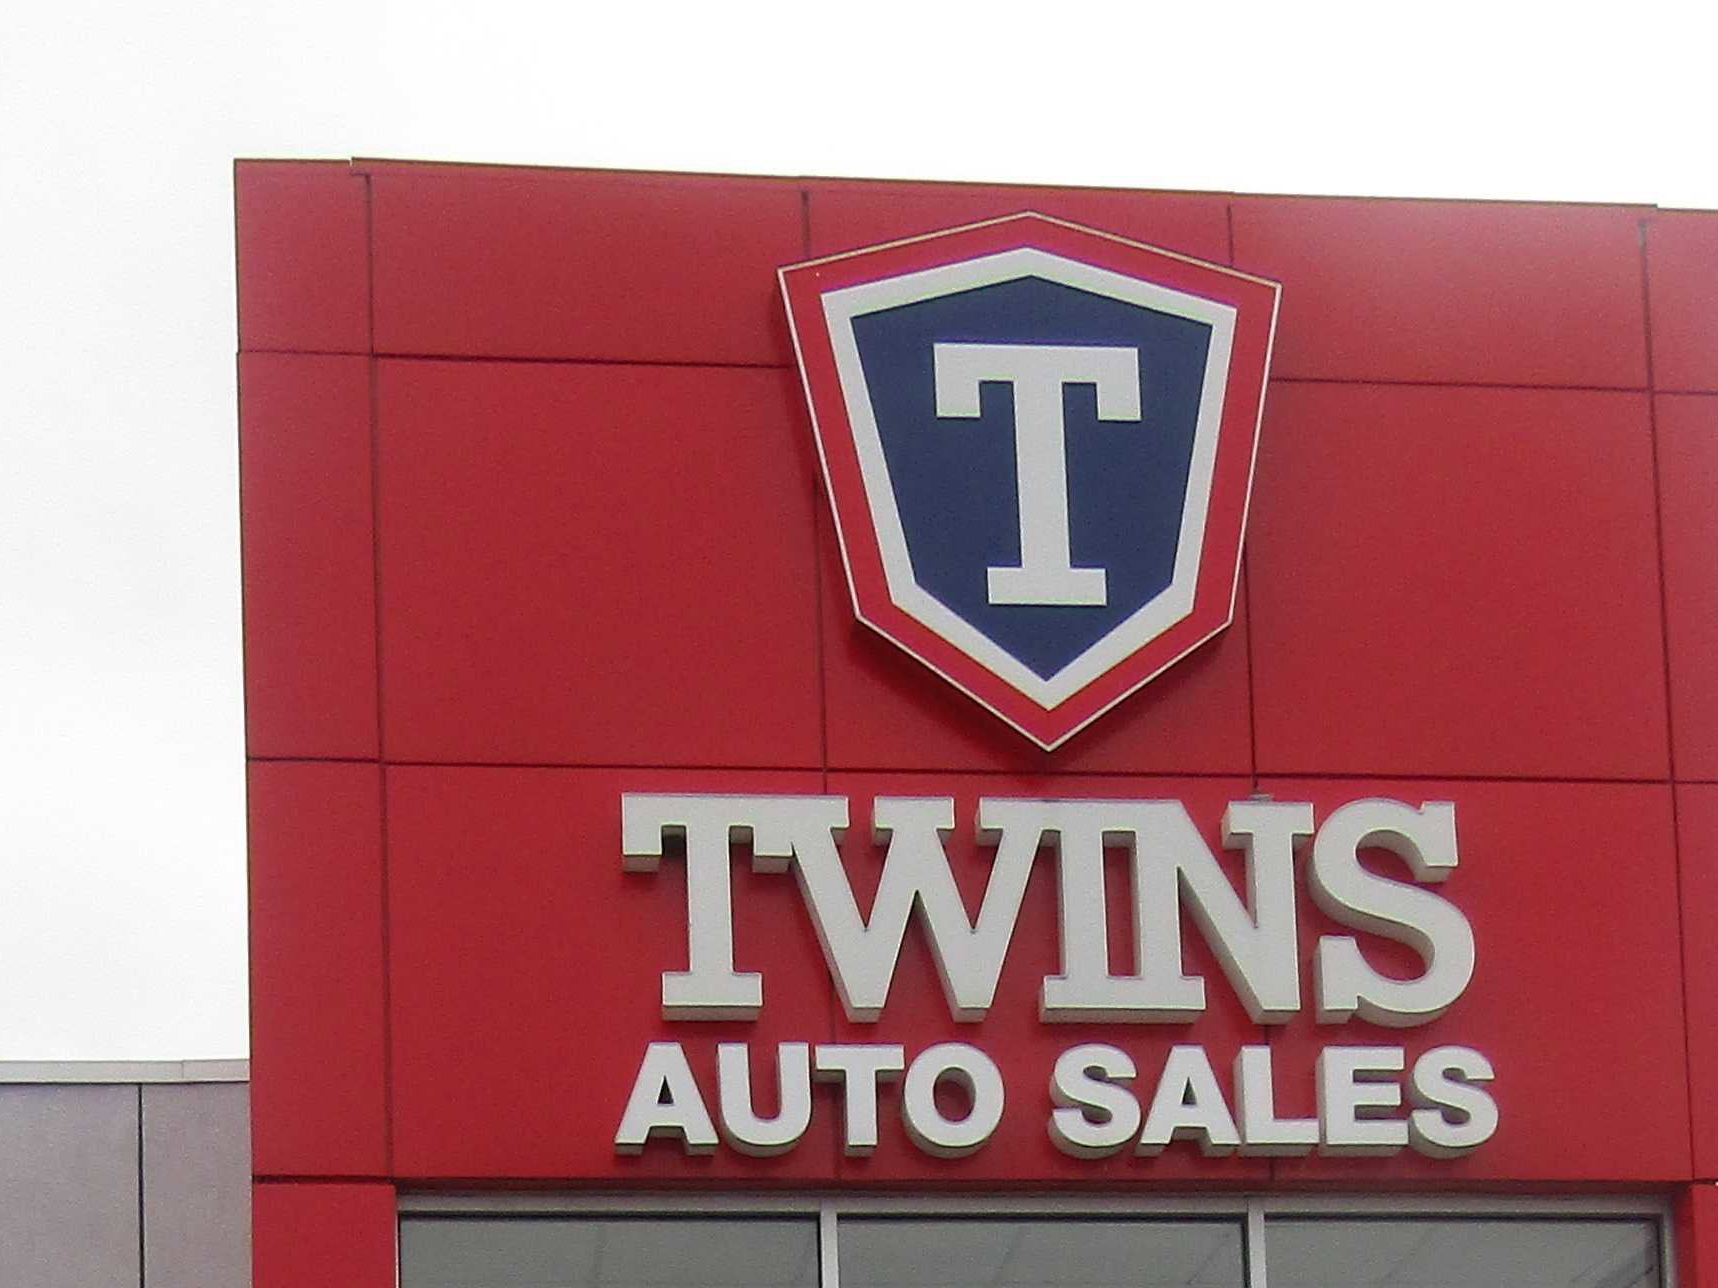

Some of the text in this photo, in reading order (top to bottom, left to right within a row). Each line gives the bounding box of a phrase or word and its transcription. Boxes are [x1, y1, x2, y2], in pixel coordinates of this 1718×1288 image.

[933, 342, 1142, 606] T
[621, 793, 1476, 1028] TWINS
[614, 1041, 1499, 1160] AUTO SALES
